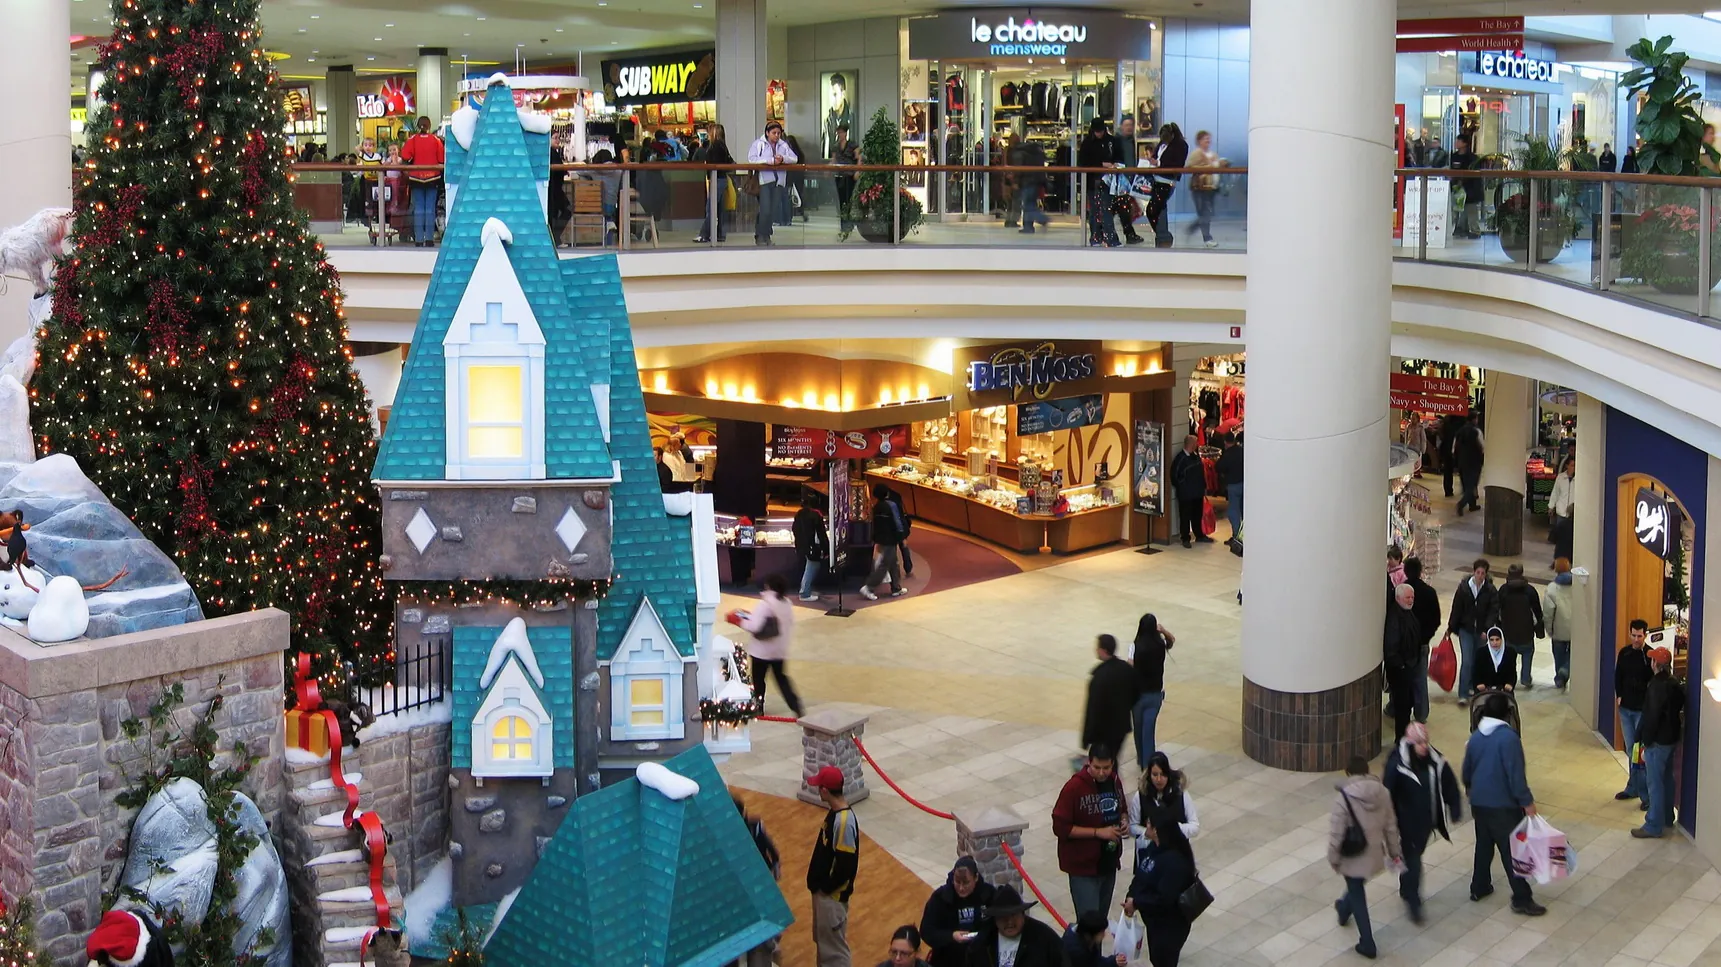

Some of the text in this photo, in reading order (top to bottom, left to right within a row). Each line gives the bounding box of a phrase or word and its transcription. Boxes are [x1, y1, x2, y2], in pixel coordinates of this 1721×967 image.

[972, 17, 992, 42] le
[1480, 20, 1511, 30] The Bay
[990, 44, 1067, 55] menswear
[1461, 39, 1511, 48] World Health
[1480, 49, 1494, 76] le
[616, 61, 696, 97] SUBWAY
[357, 95, 384, 117] Edo
[970, 352, 1096, 391] BEN MOSS
[1423, 381, 1455, 394] The Bay
[1390, 396, 1455, 411] Navy Shoppers
